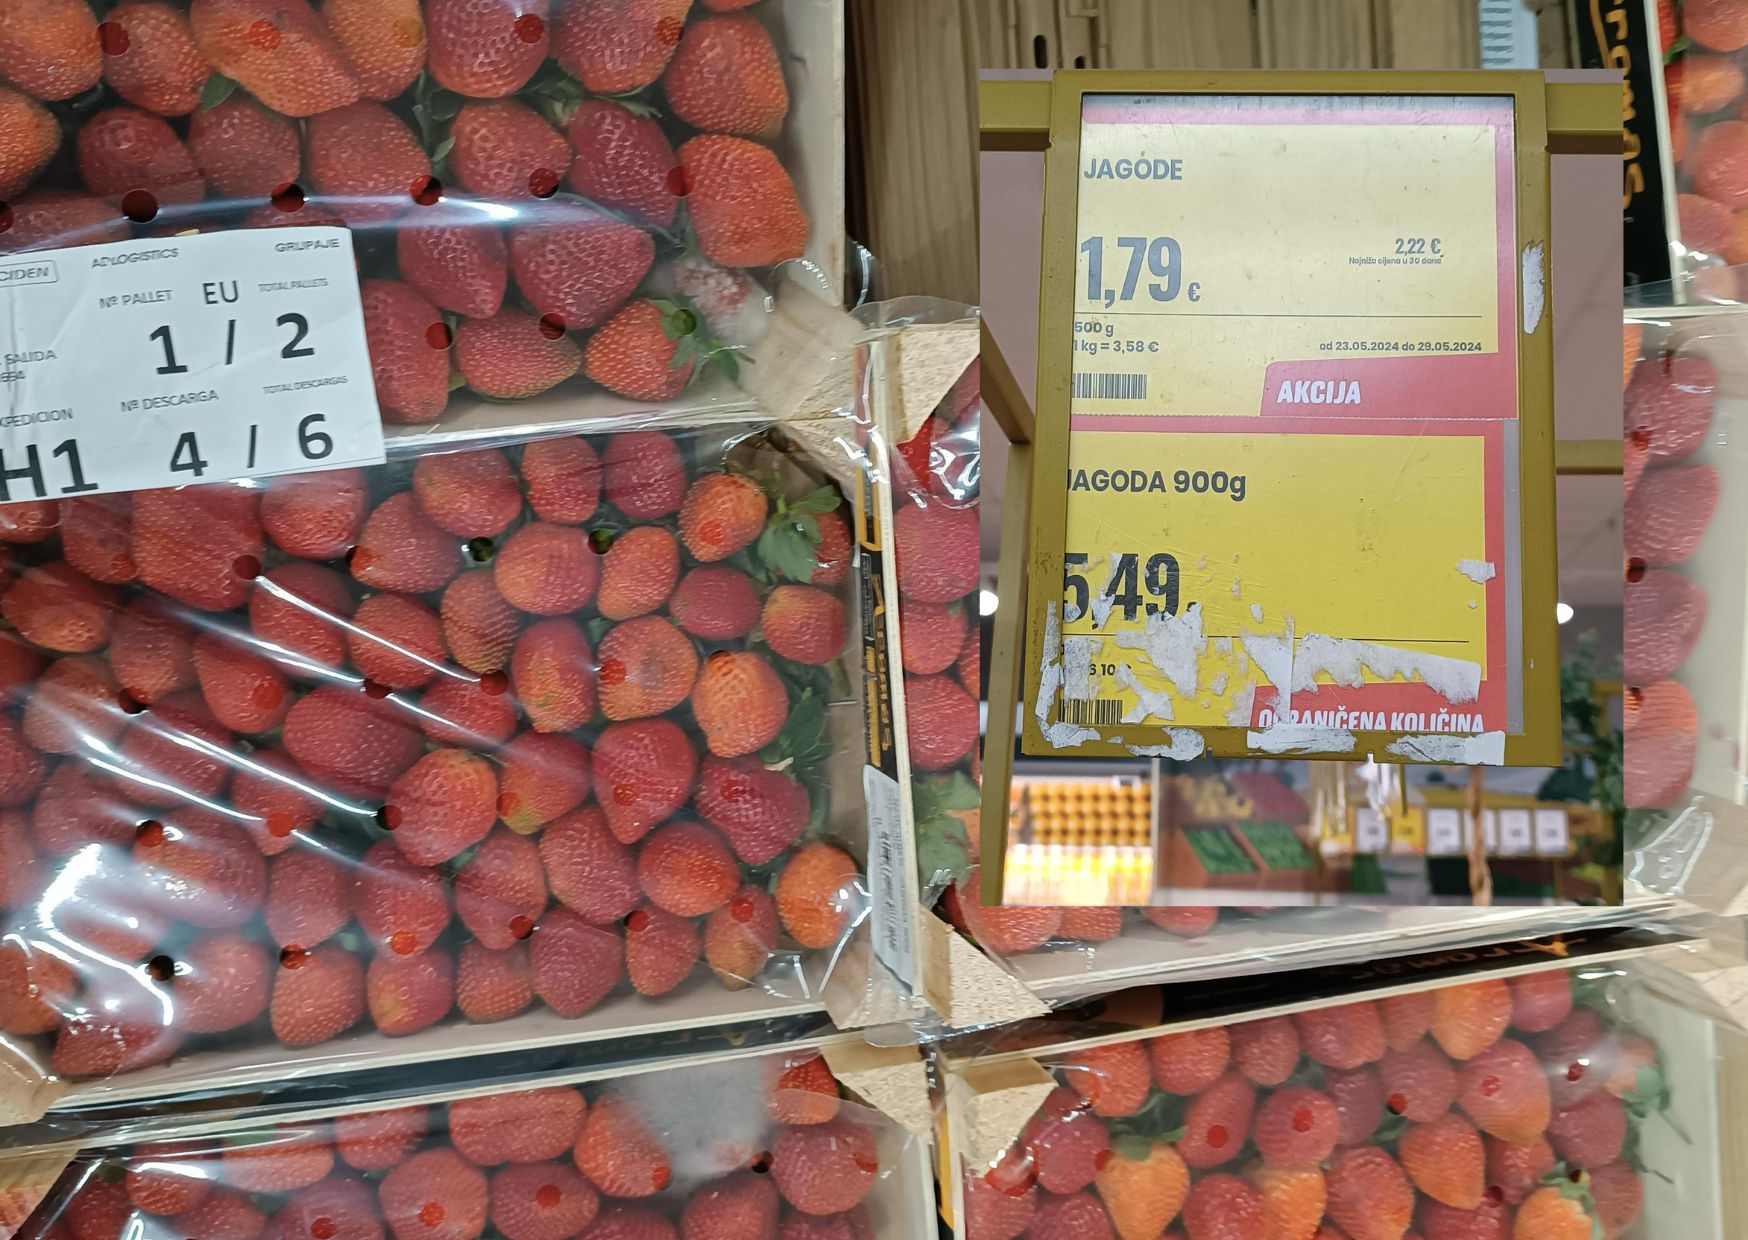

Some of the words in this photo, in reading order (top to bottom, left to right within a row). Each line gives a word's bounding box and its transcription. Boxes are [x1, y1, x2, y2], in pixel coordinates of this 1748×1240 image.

[1083, 158, 1183, 181] JAGODE
[274, 238, 341, 252] GRUPAJE
[1395, 237, 1426, 256] 2,22
[1430, 237, 1441, 255] €
[1080, 236, 1182, 309] 1,79
[1188, 282, 1201, 302] €
[1348, 256, 1377, 266] Najniža
[1377, 256, 1401, 267] cijena
[1409, 257, 1420, 265] 30
[1421, 257, 1442, 265] dana
[122, 289, 173, 306] PALLET
[202, 280, 240, 304] EU
[1073, 321, 1103, 333] 500
[1105, 324, 1114, 337] g
[149, 325, 189, 375] 1
[276, 312, 315, 359] 2
[1081, 340, 1097, 355] kg
[1100, 342, 1110, 350] =
[1113, 340, 1144, 354] 3,58
[1147, 341, 1159, 353] €
[1319, 341, 1333, 351] od
[1335, 341, 1399, 351] 23.05.2024
[1401, 342, 1415, 351] do
[1417, 341, 1482, 352] 29.05.2024
[143, 389, 220, 410] DESCARGA
[1276, 380, 1361, 404] AKCIJA
[169, 432, 208, 477] 4
[298, 413, 334, 460] 6
[1173, 470, 1246, 502] 900g
[1258, 705, 1387, 730] ORANIČENA
[1390, 707, 1485, 733] KOLIČINA
